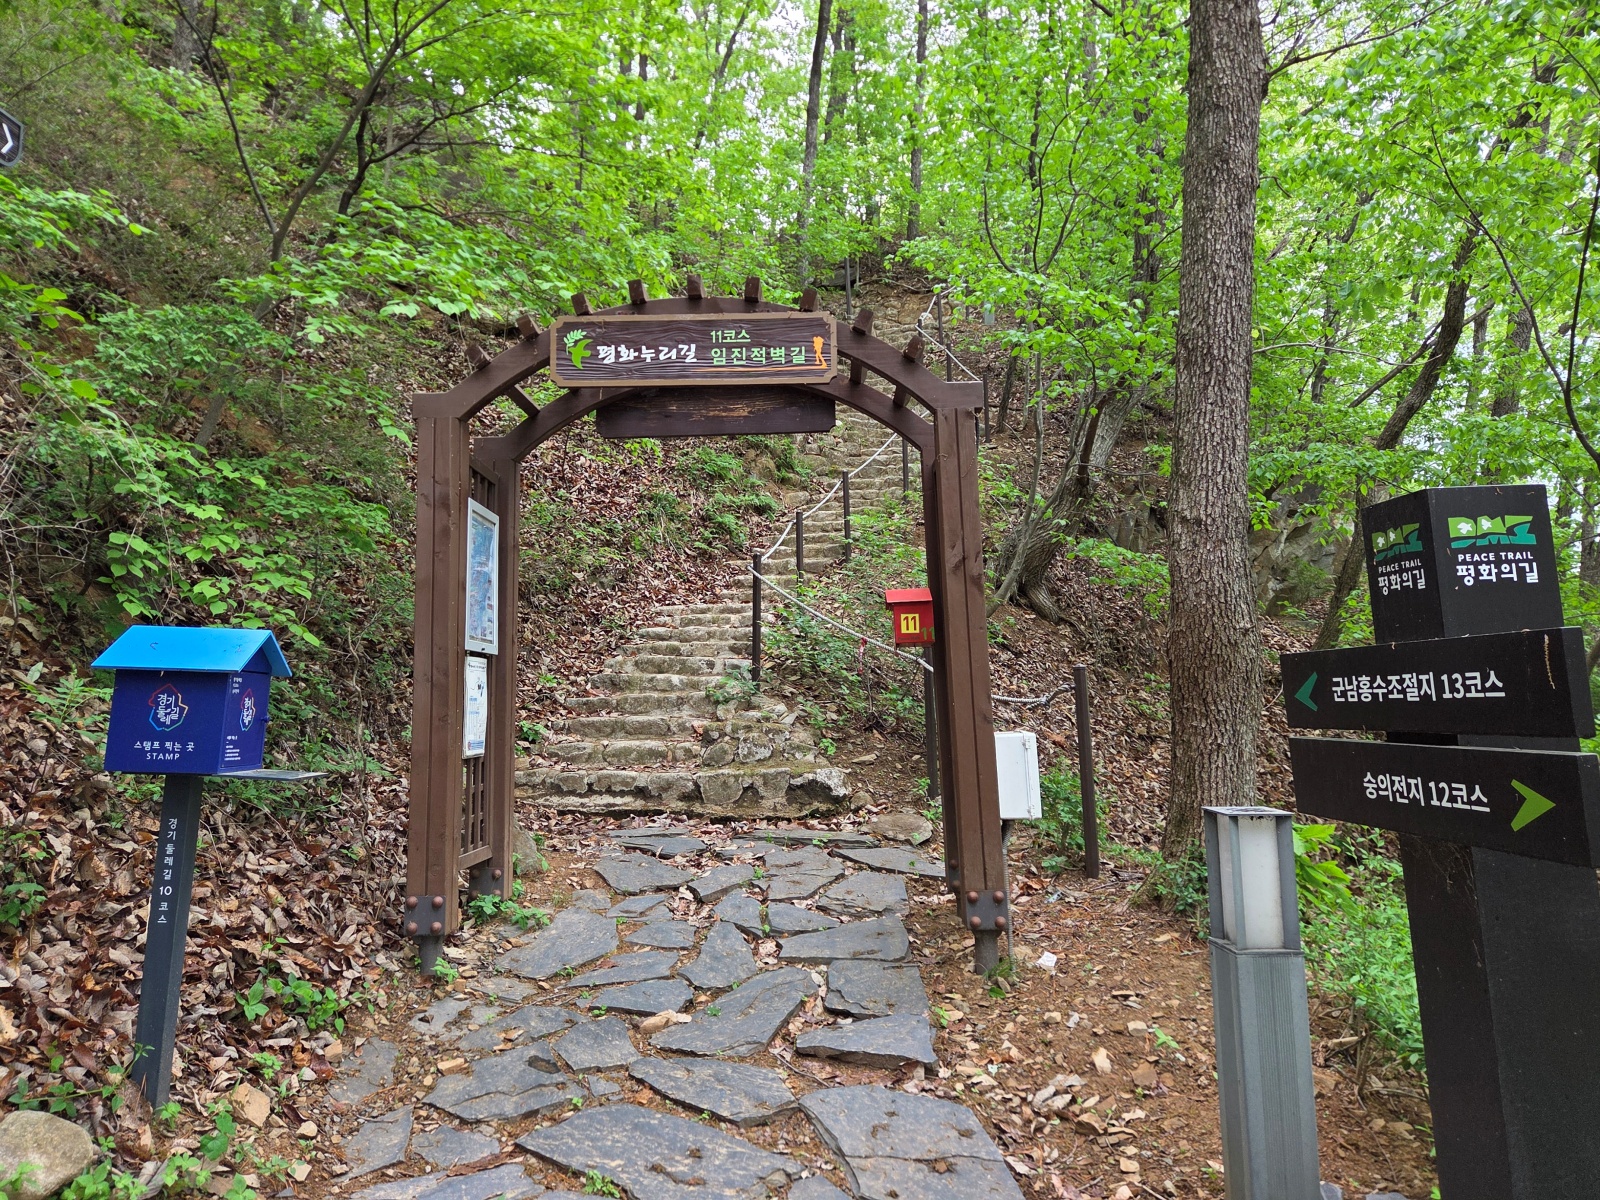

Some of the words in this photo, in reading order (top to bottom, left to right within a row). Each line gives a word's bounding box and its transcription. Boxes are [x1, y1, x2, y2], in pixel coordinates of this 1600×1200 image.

[710, 330, 751, 344] 11코스
[597, 344, 698, 364] 평화누리길
[711, 346, 806, 366] 임진적벽길
[1458, 553, 1496, 563] PEACE
[1500, 551, 1534, 561] TRAIL
[1378, 563, 1399, 574] PEACE
[1401, 559, 1422, 569] TRAIL
[1456, 562, 1539, 587] 평화의길
[1378, 568, 1426, 596] 평화의길
[903, 615, 917, 631] 11
[1332, 672, 1437, 702] 군남홍수조절지
[1441, 670, 1506, 699] 13코스
[186, 742, 195, 751] 곳
[146, 752, 180, 760] STAMP
[1363, 771, 1425, 806] 숭의전지
[1428, 781, 1490, 812] 12코스
